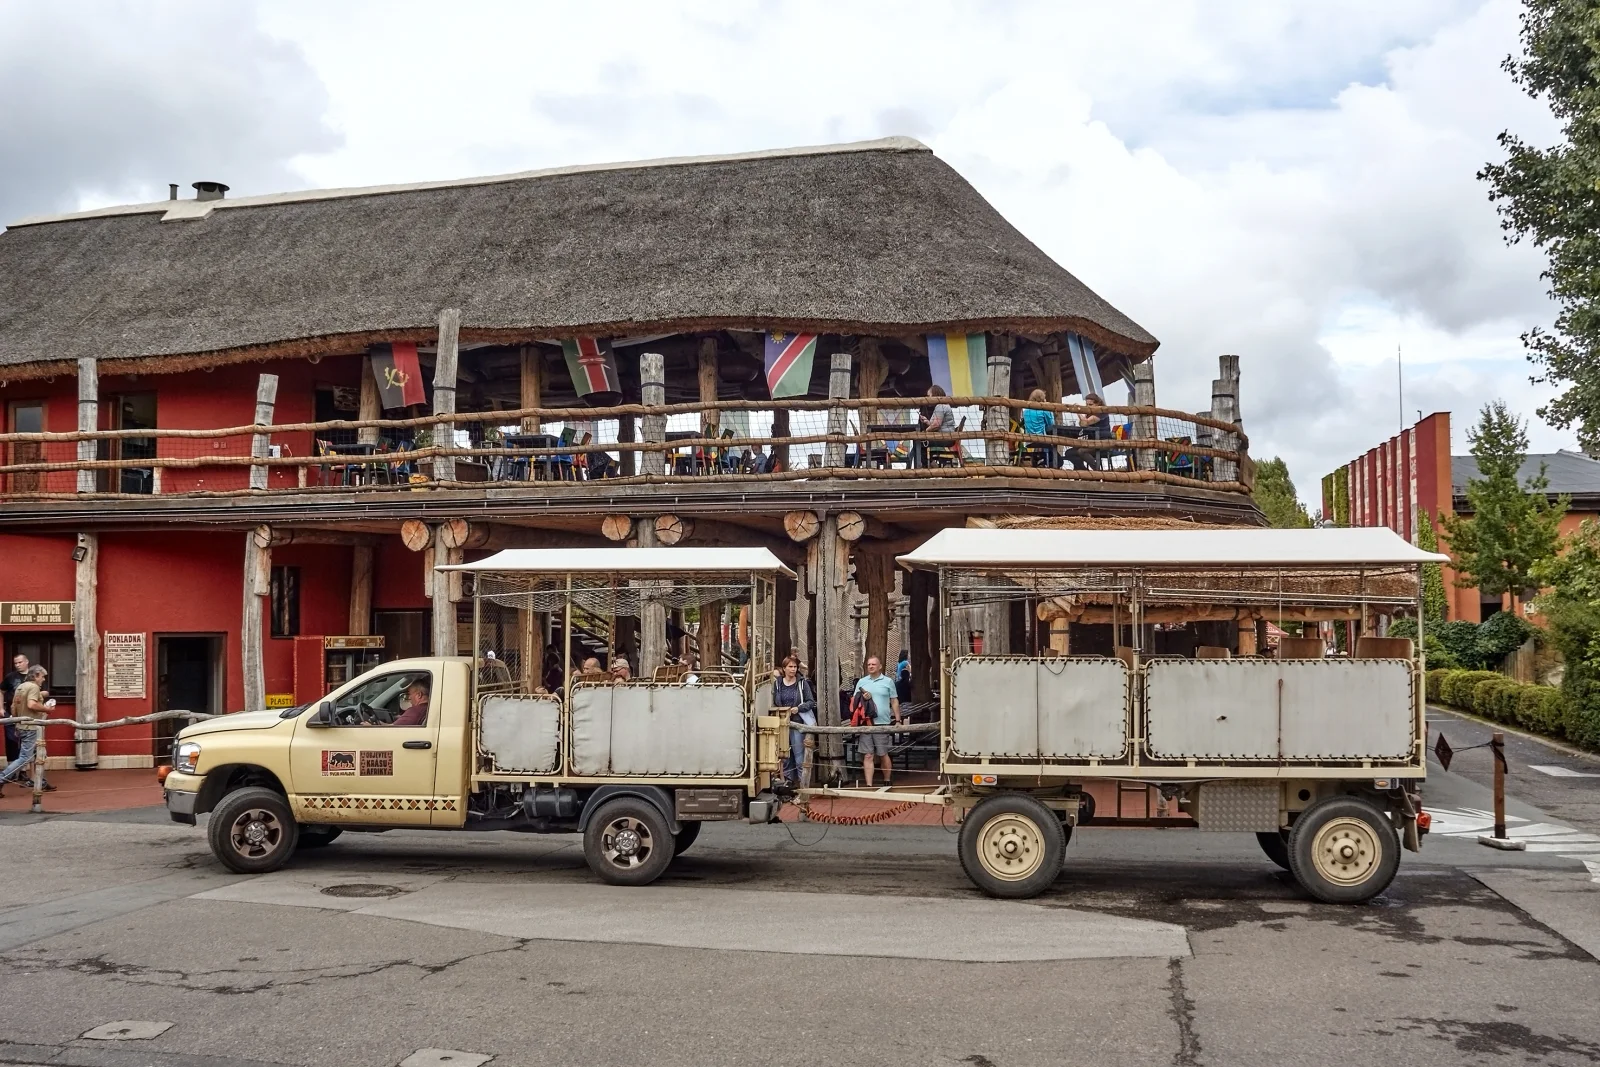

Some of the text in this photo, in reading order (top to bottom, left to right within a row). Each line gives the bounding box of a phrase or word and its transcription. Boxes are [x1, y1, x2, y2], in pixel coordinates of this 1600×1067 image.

[11, 604, 36, 614] AFRICA
[38, 604, 60, 614] TRUCK
[108, 635, 141, 643] POKLADNA
[366, 758, 387, 767] KRÁSU
